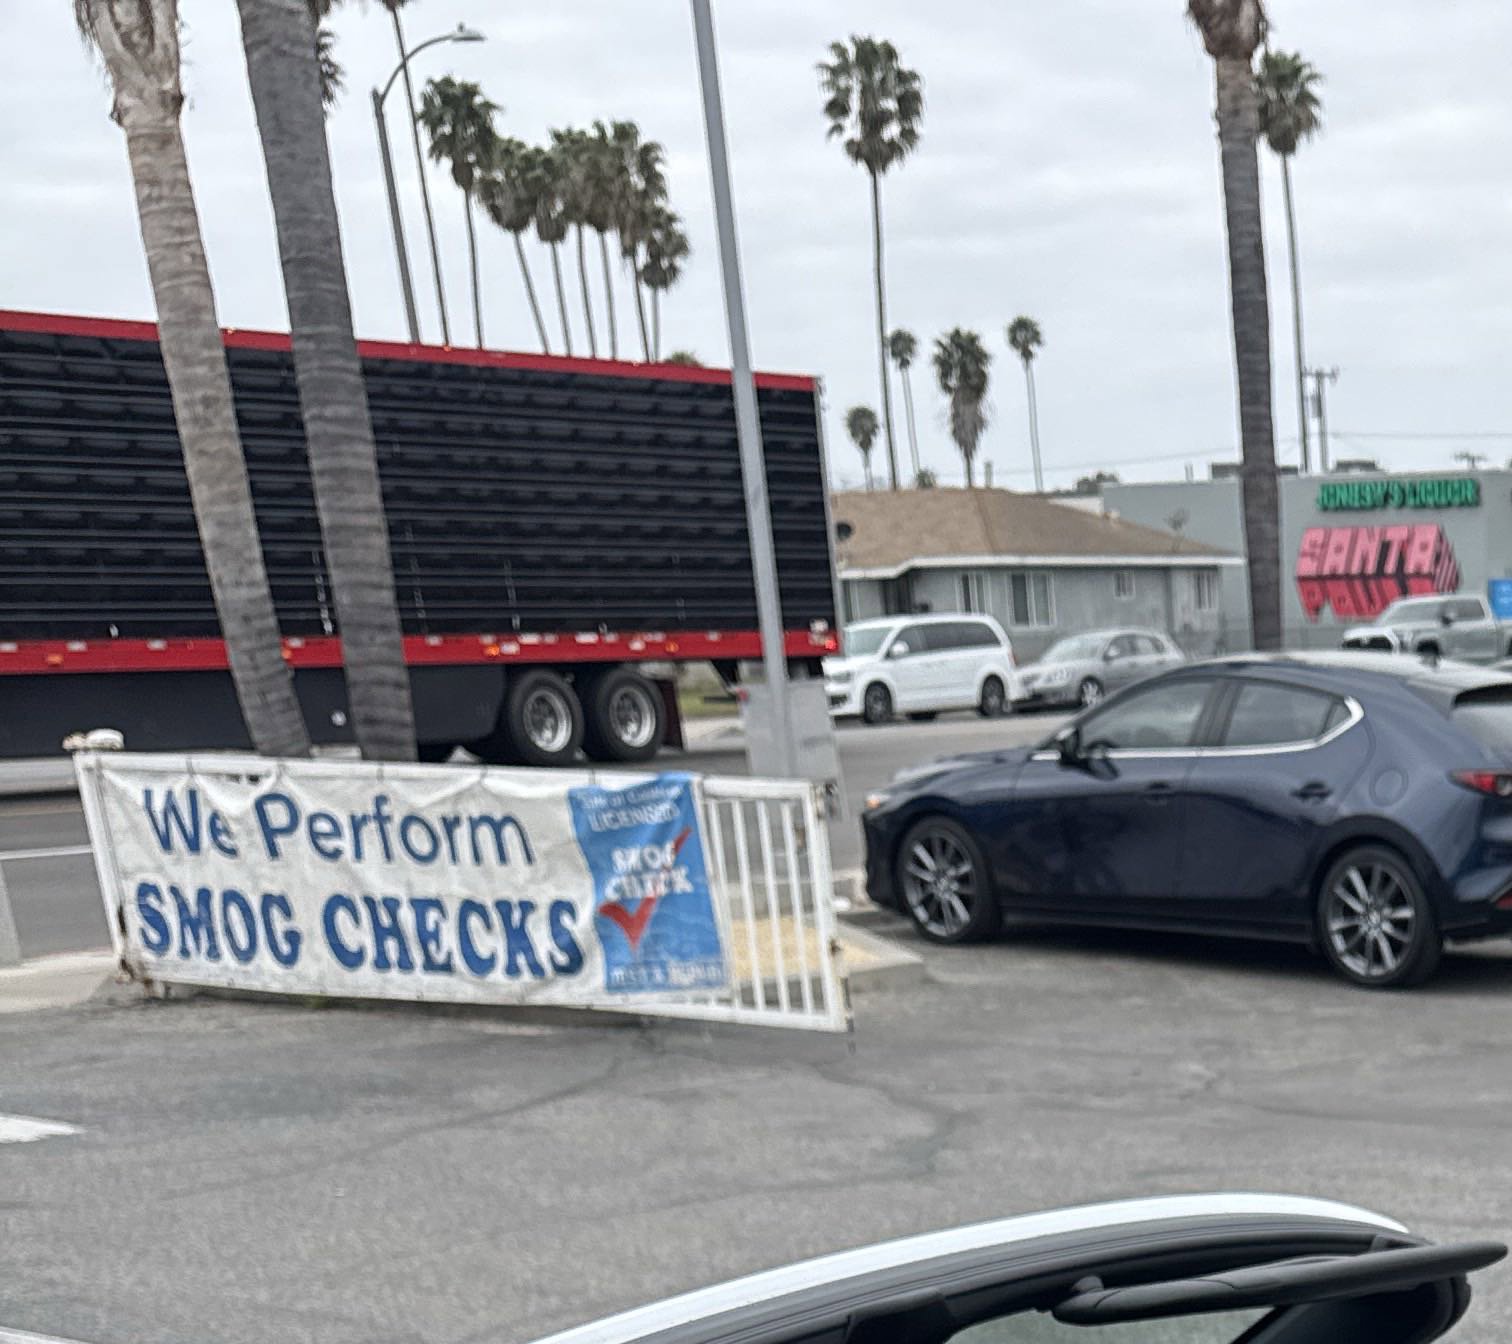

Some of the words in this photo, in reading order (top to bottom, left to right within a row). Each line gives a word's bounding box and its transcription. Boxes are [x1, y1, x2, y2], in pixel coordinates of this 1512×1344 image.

[1407, 477, 1480, 509] LIQUOR
[1296, 523, 1440, 577] SANTA
[144, 788, 239, 858] We
[254, 792, 536, 866] Perform
[136, 882, 303, 968] SMOG
[323, 894, 584, 978] CHECKS
